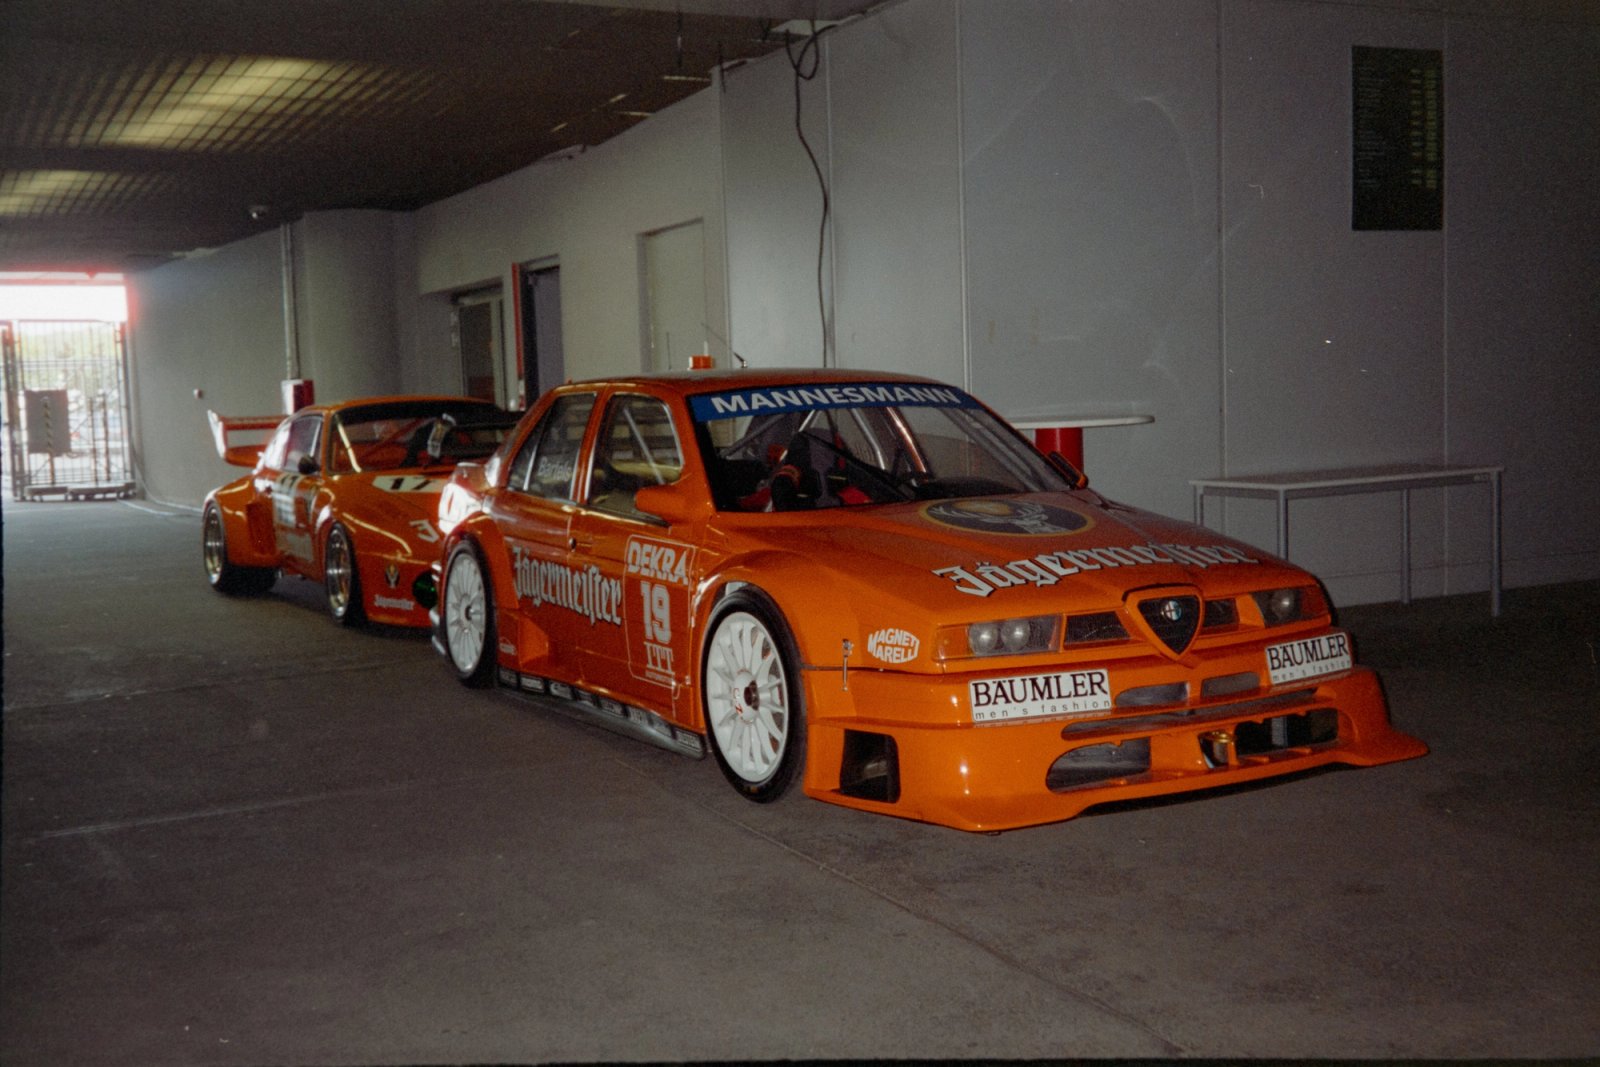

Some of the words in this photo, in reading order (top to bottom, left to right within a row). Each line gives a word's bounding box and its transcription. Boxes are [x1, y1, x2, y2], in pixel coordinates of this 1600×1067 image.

[711, 386, 960, 413] MANNESMANN
[627, 541, 689, 585] DEKRA
[640, 580, 671, 645] 19
[643, 641, 675, 676] ITT
[1267, 634, 1349, 671] BÄUMLER
[972, 671, 1108, 707] BÄUMLER
[975, 706, 1029, 720] men's
[1041, 700, 1111, 714] fashion
